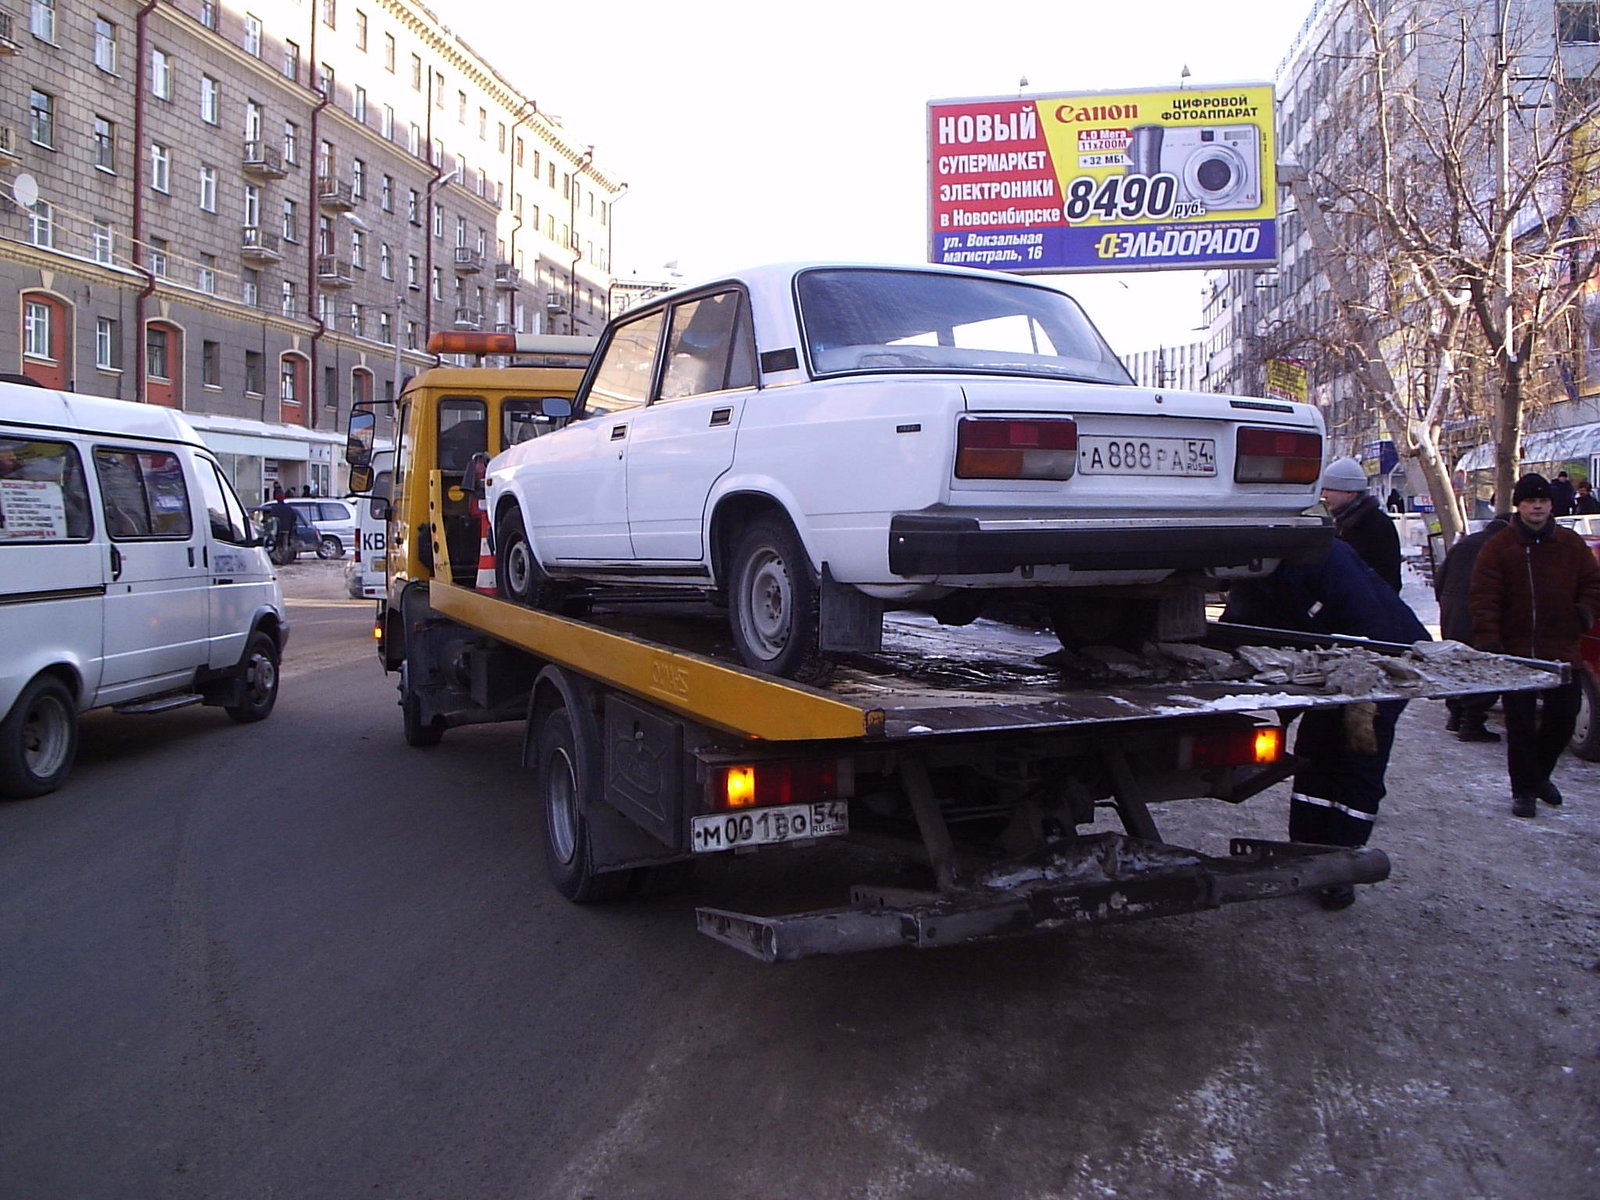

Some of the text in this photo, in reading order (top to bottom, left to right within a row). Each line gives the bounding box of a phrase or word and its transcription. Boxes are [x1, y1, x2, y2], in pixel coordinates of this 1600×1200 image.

[1173, 94, 1248, 110] ЦИФРОВОЙ
[1055, 104, 1138, 123] Canon
[1161, 107, 1258, 120] ФОТОАППАРАТ
[939, 106, 1036, 144] НОВЫЙ
[939, 151, 1046, 174] СУПЕРМАРКЕТ
[940, 179, 1054, 201] ЭЛЕКТРОНИКИ
[1066, 175, 1204, 220] 8490 руб.
[940, 207, 1060, 227] в Новосибирске
[943, 233, 1043, 251] ул. Вокзальная
[943, 246, 1043, 264] магистраль, 16
[812, 823, 832, 834] RUS
